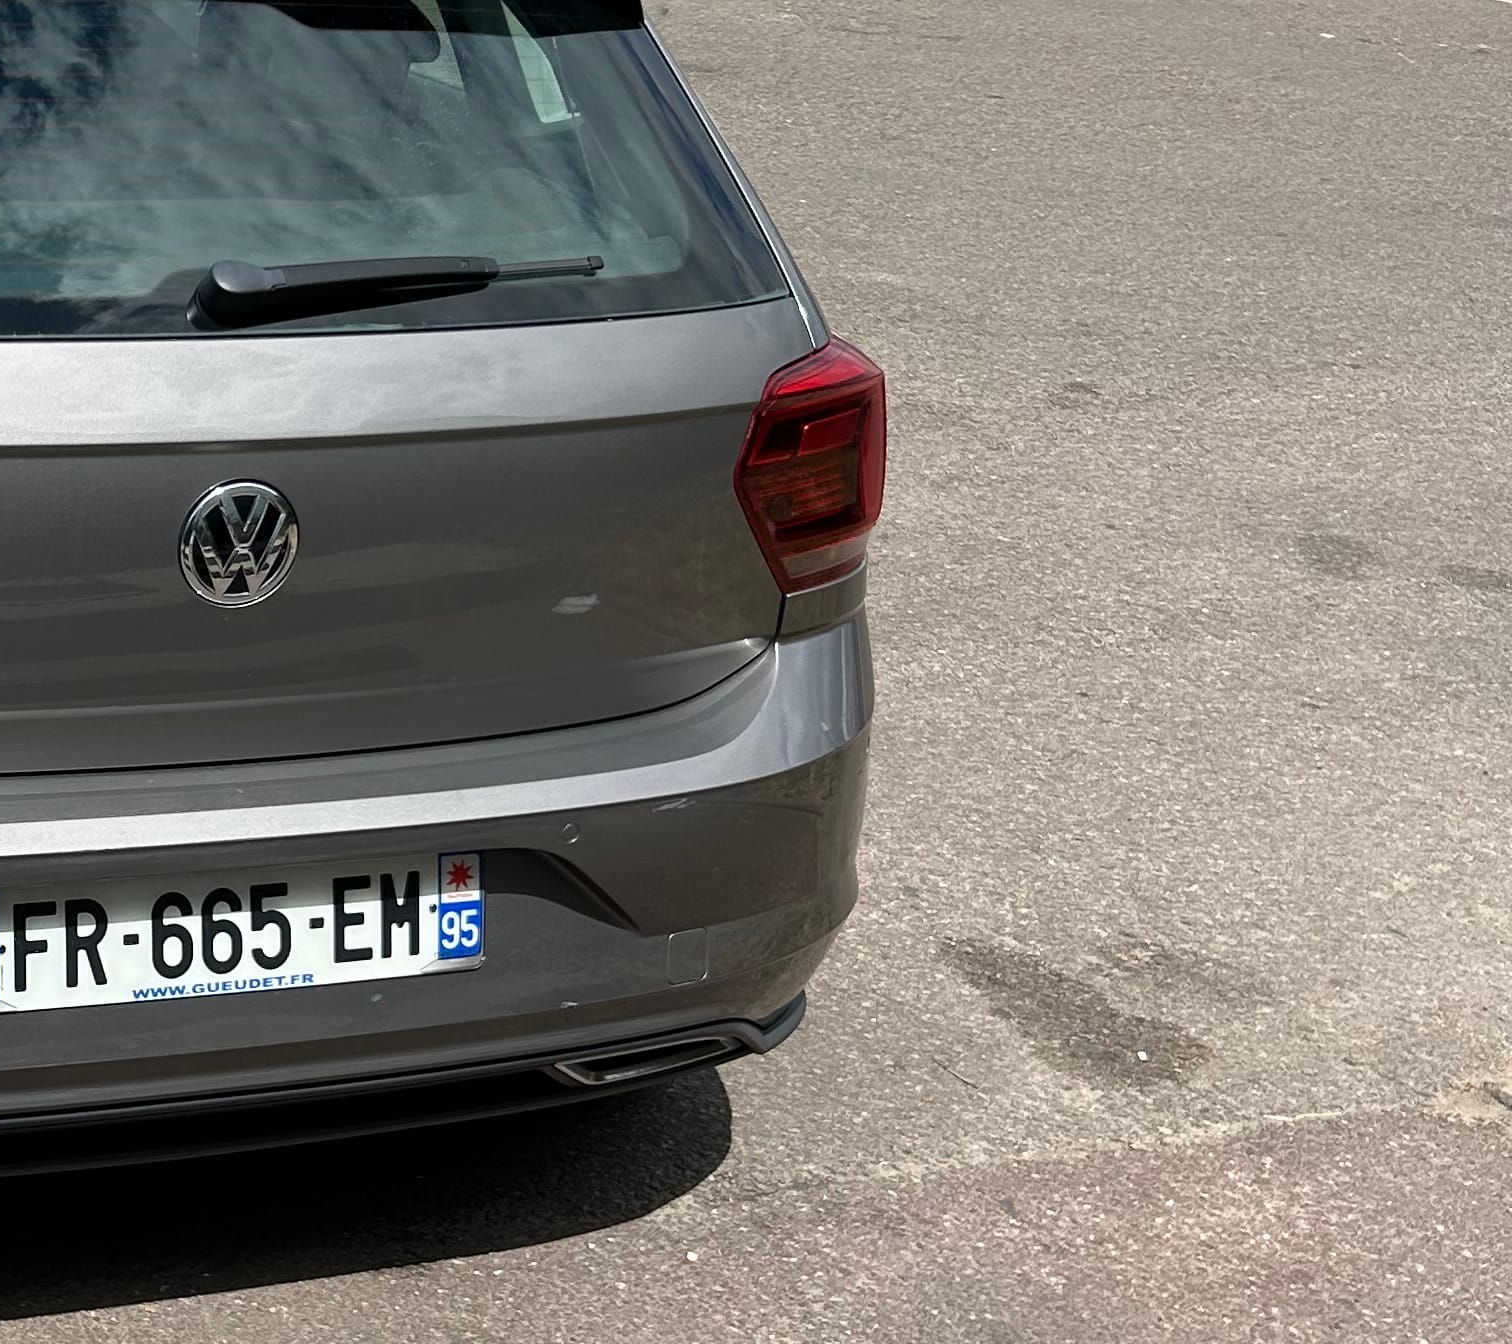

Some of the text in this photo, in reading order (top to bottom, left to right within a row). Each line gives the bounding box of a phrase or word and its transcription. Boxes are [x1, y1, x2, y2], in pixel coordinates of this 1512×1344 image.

[12, 869, 421, 993] FR-665-EM
[441, 908, 480, 950] 95
[132, 973, 315, 1000] WWW.GUEUDET.FR
